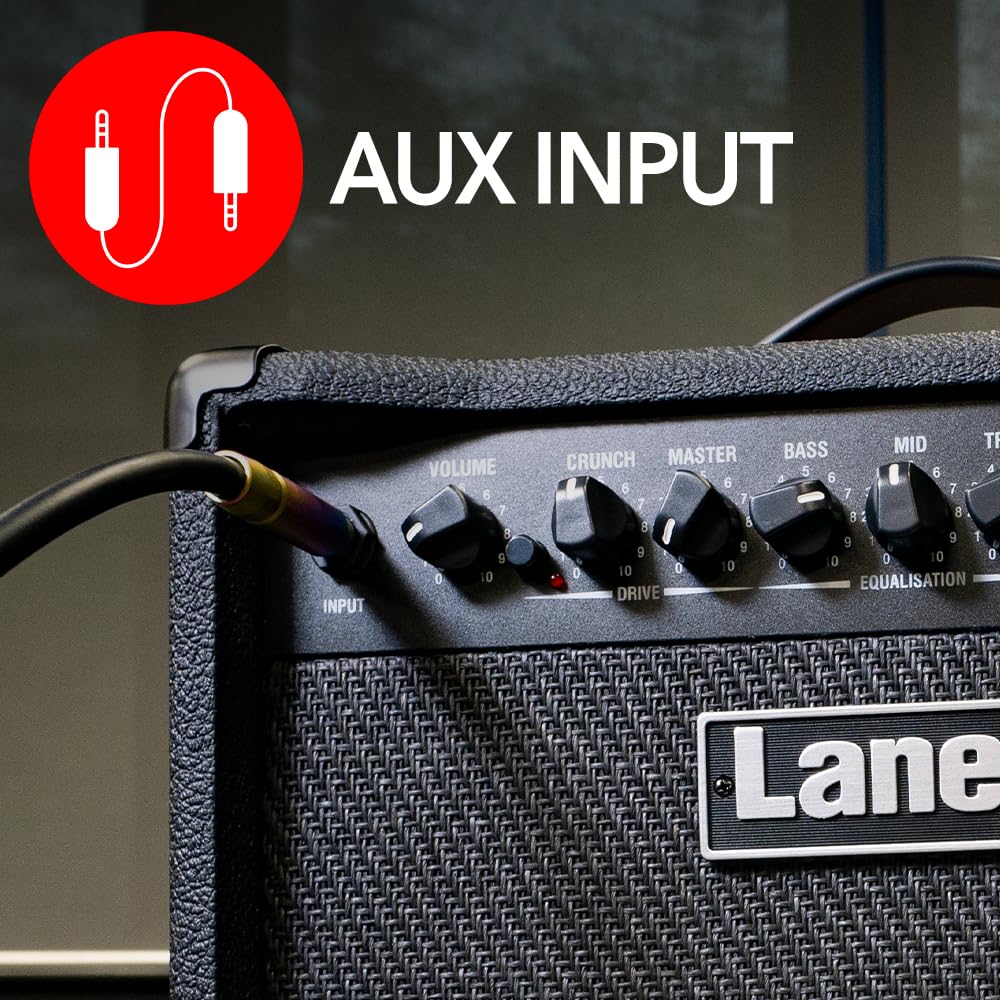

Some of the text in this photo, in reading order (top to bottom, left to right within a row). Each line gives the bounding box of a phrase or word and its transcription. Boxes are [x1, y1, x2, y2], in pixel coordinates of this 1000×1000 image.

[784, 440, 829, 460] BASS
[894, 435, 927, 454] MID
[566, 450, 636, 470] CRUNCH
[668, 445, 737, 465] MASTER
[429, 457, 497, 478] VOLUME
[802, 466, 810, 478] 5
[933, 466, 940, 478] 6
[724, 477, 732, 488] 6
[828, 472, 836, 483] 6
[622, 482, 630, 494] 6
[845, 488, 852, 499] 7
[950, 483, 957, 494] 7
[483, 489, 490, 500] 6
[741, 493, 748, 504] 7
[850, 512, 856, 522] 8
[955, 506, 962, 518] 8
[641, 521, 648, 532] 8
[504, 528, 511, 540] 8
[950, 532, 956, 544] 9
[740, 541, 748, 552] 9
[844, 536, 852, 548] 9
[638, 546, 644, 558] 9
[988, 548, 996, 560] 0
[498, 553, 506, 564] 9
[778, 558, 786, 570] 0
[883, 553, 890, 564] 0
[573, 567, 580, 579] 0
[675, 562, 682, 574] 0
[435, 573, 442, 584] 0
[860, 572, 966, 590] EQUALISATION
[617, 585, 660, 601] DRIVE
[323, 598, 365, 614] INPUT
